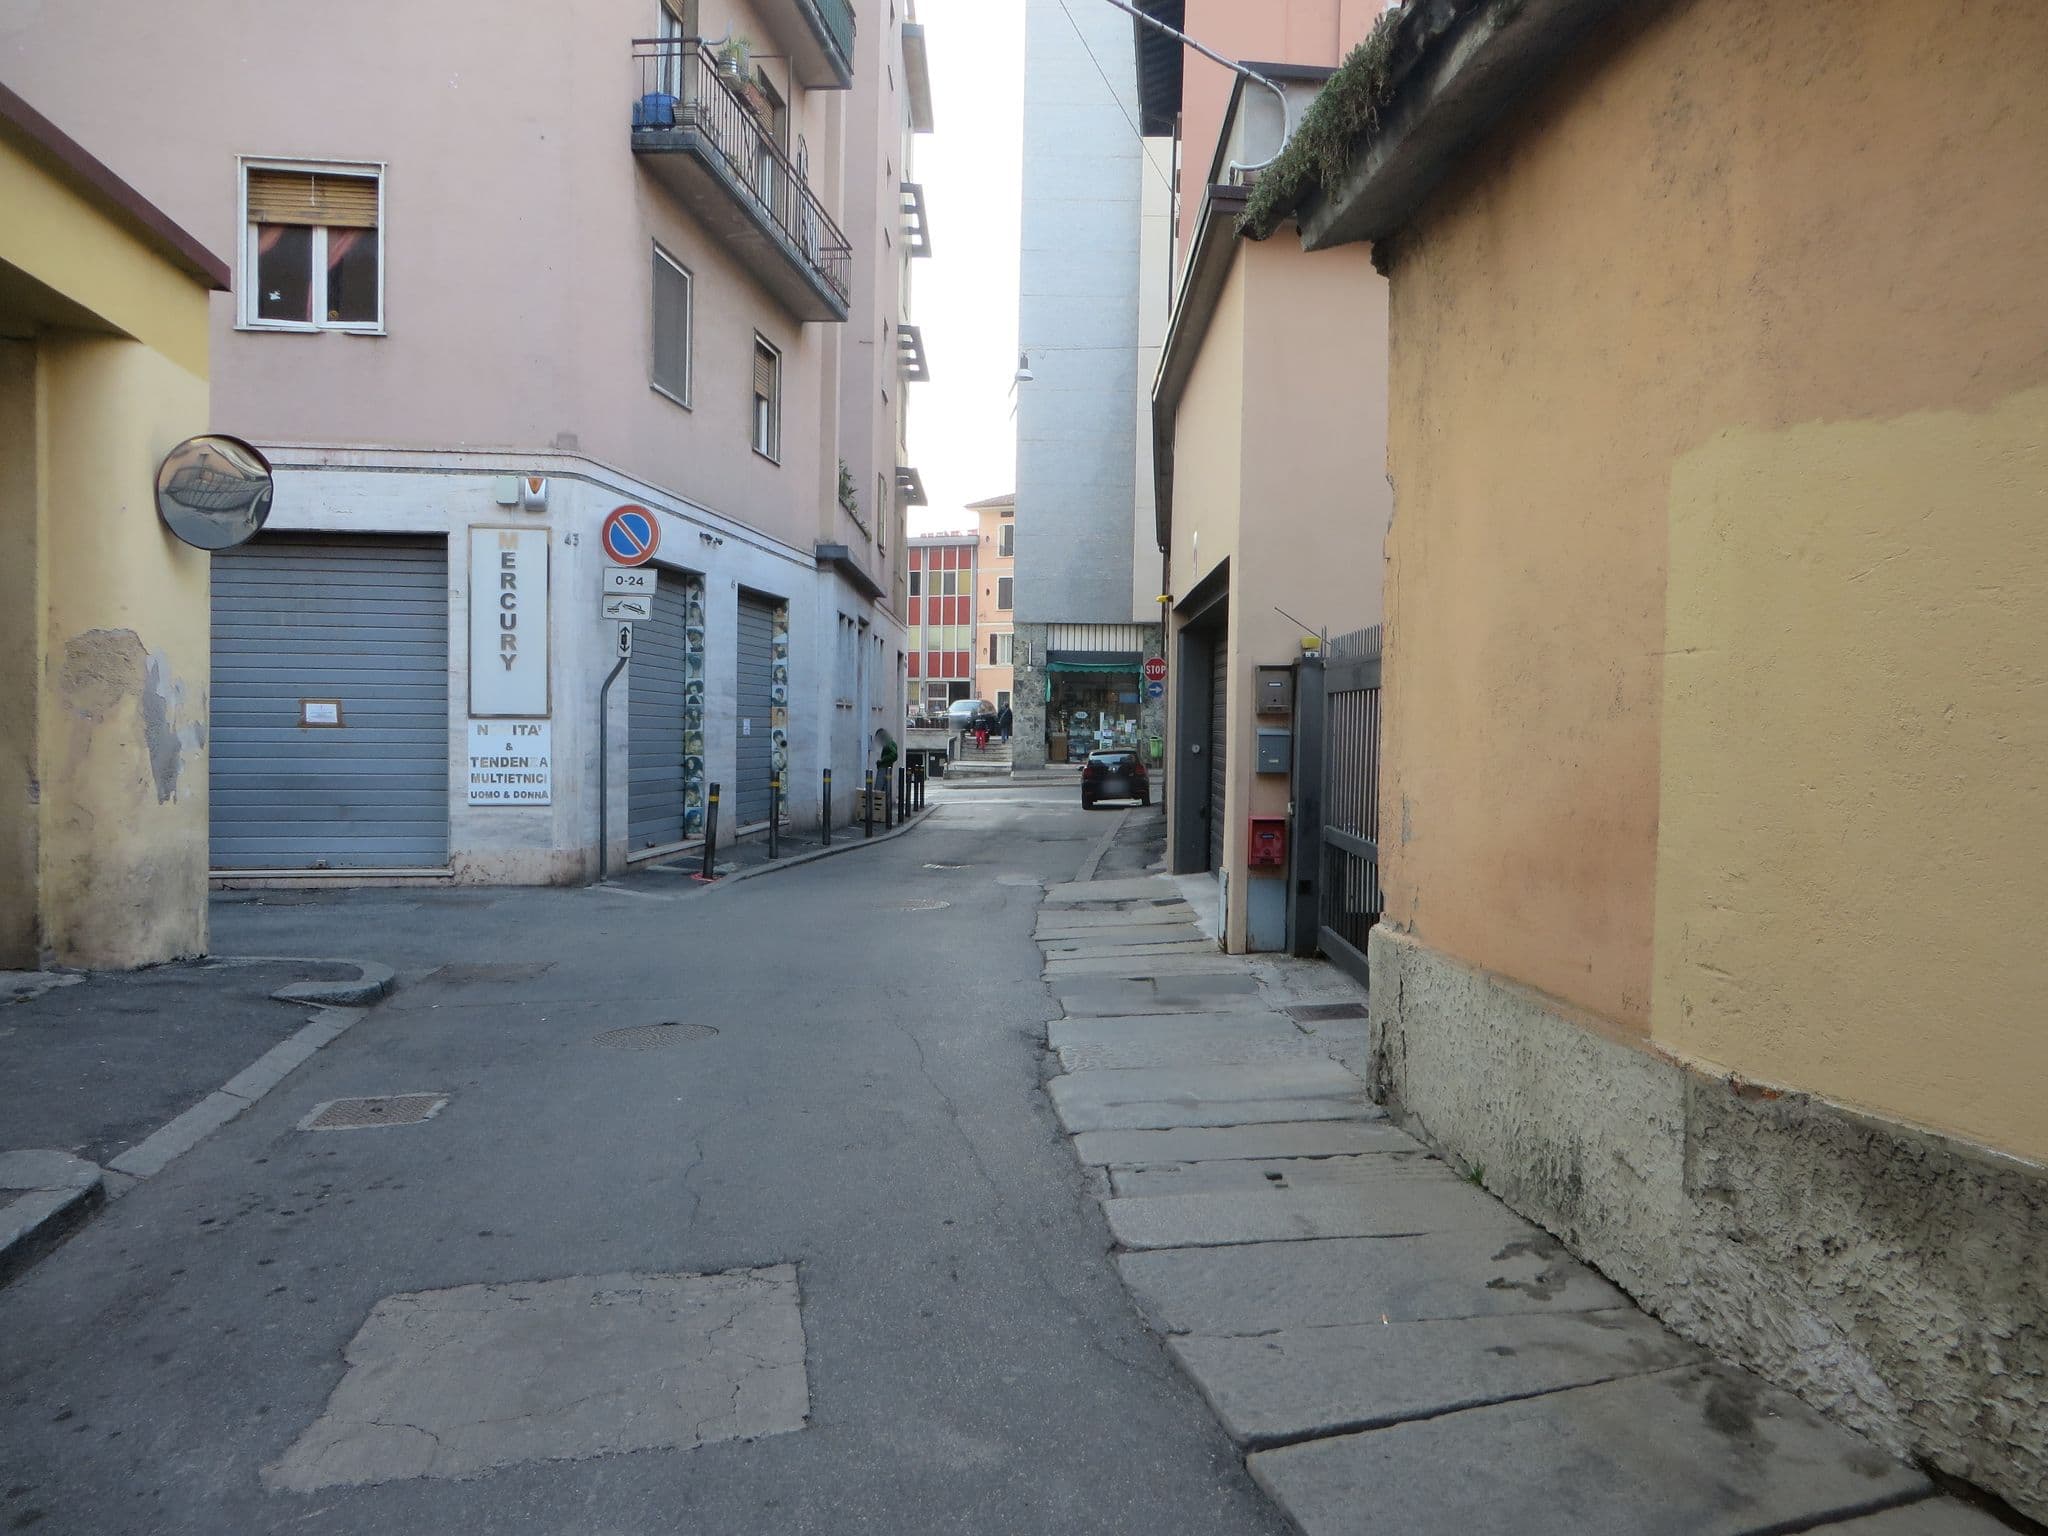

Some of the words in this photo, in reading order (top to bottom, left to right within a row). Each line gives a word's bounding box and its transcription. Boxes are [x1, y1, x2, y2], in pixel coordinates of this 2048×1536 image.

[615, 576, 644, 587] 0-24
[499, 531, 518, 672] MERCURY
[1146, 665, 1166, 674] STOP
[505, 742, 513, 751] &
[470, 756, 548, 768] TENDENA
[470, 790, 500, 799] UOMO
[503, 790, 510, 799] &
[513, 790, 549, 799] DONNA
